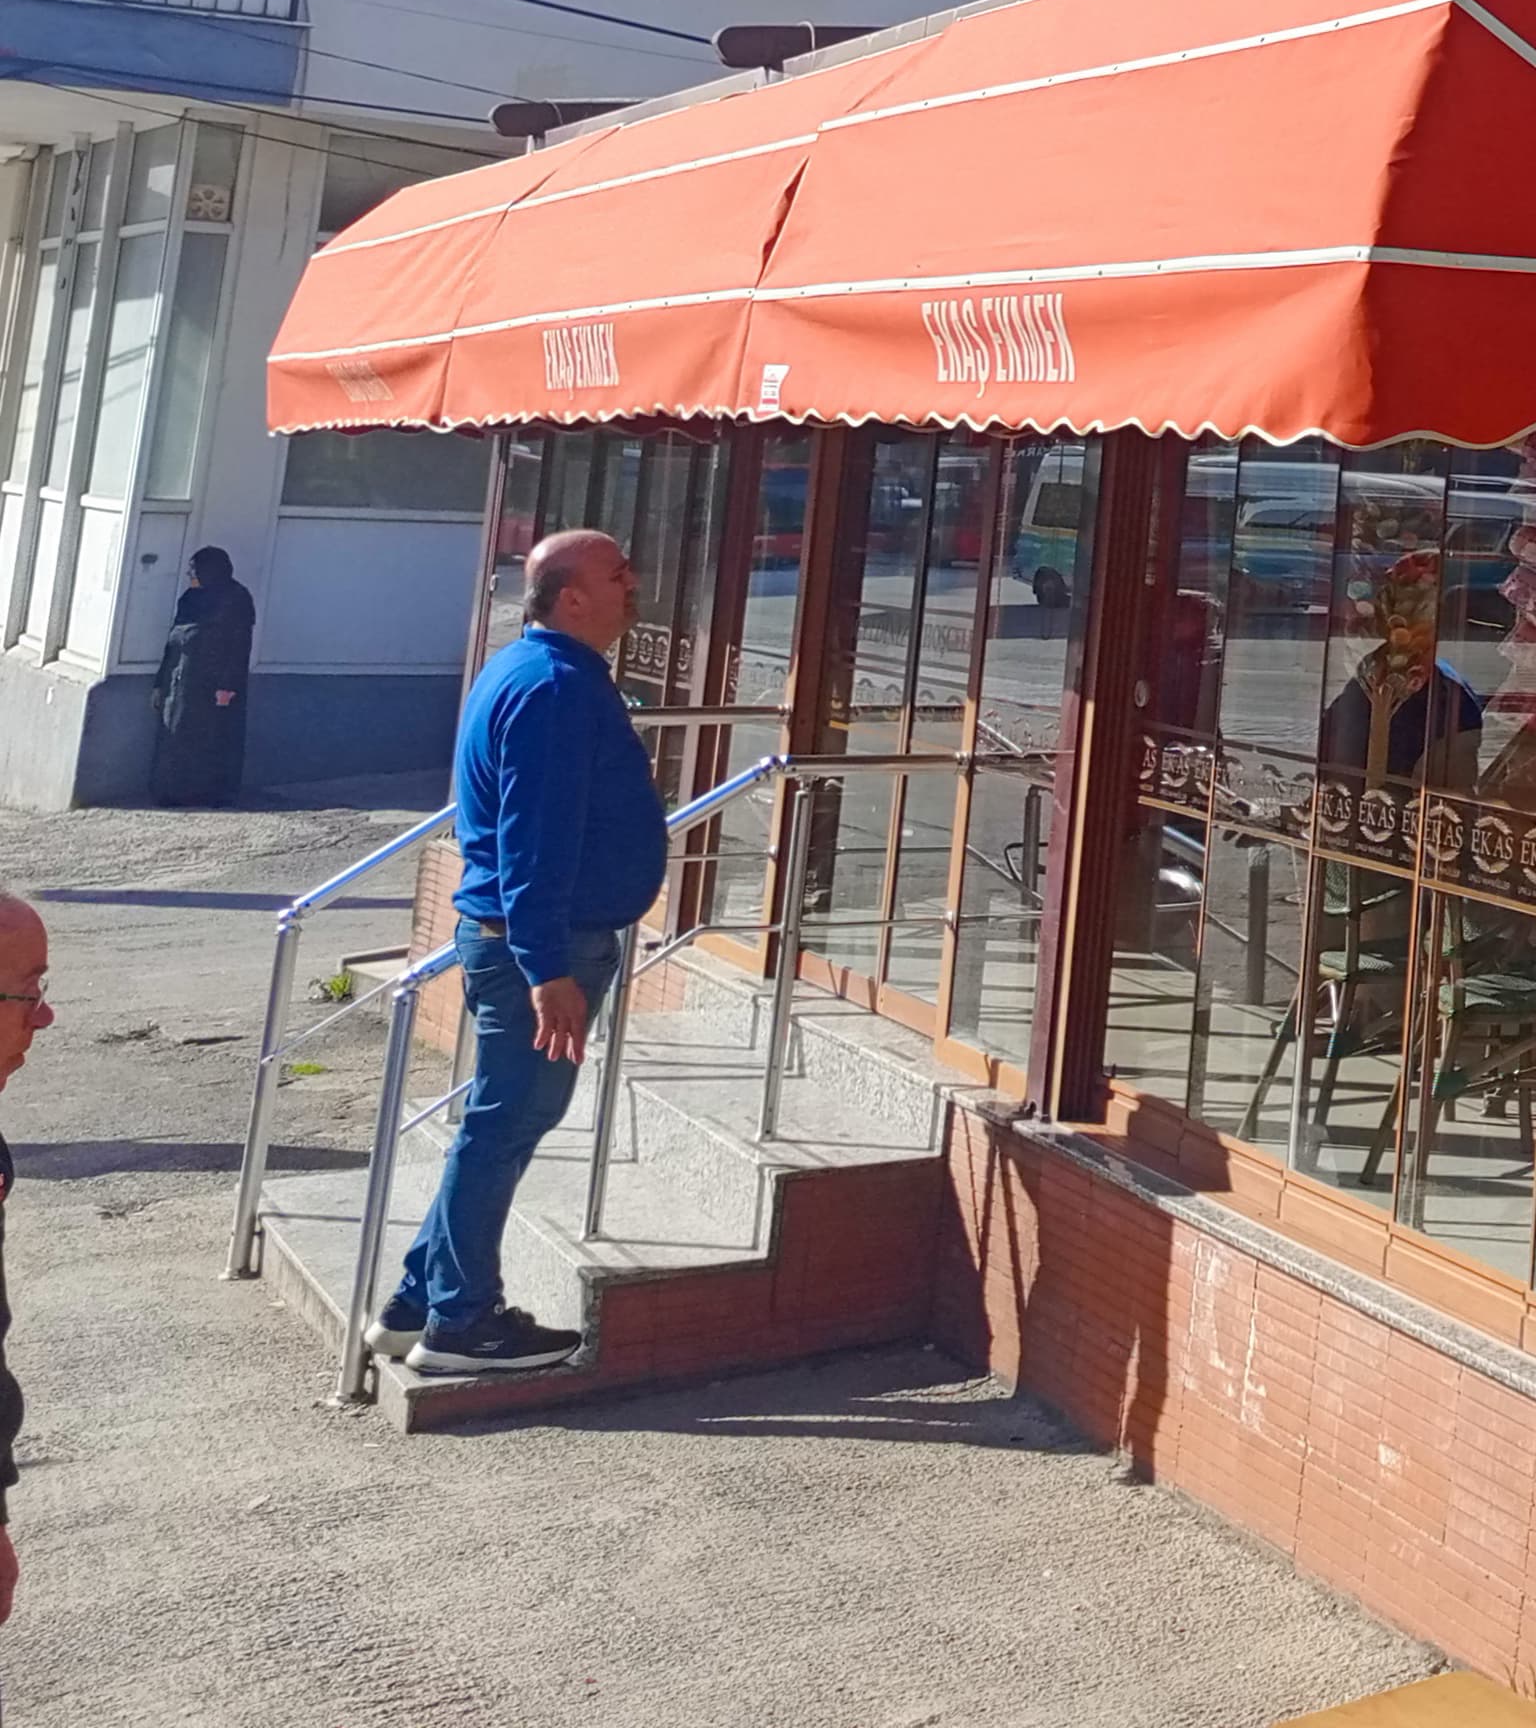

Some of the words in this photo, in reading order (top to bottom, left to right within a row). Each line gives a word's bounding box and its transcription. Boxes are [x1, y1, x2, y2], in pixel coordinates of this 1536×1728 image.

[921, 297, 990, 399] EKAŞ
[981, 293, 1076, 383] EKMEK
[1358, 801, 1396, 829] EKAS
[1471, 828, 1514, 860] EKAS
